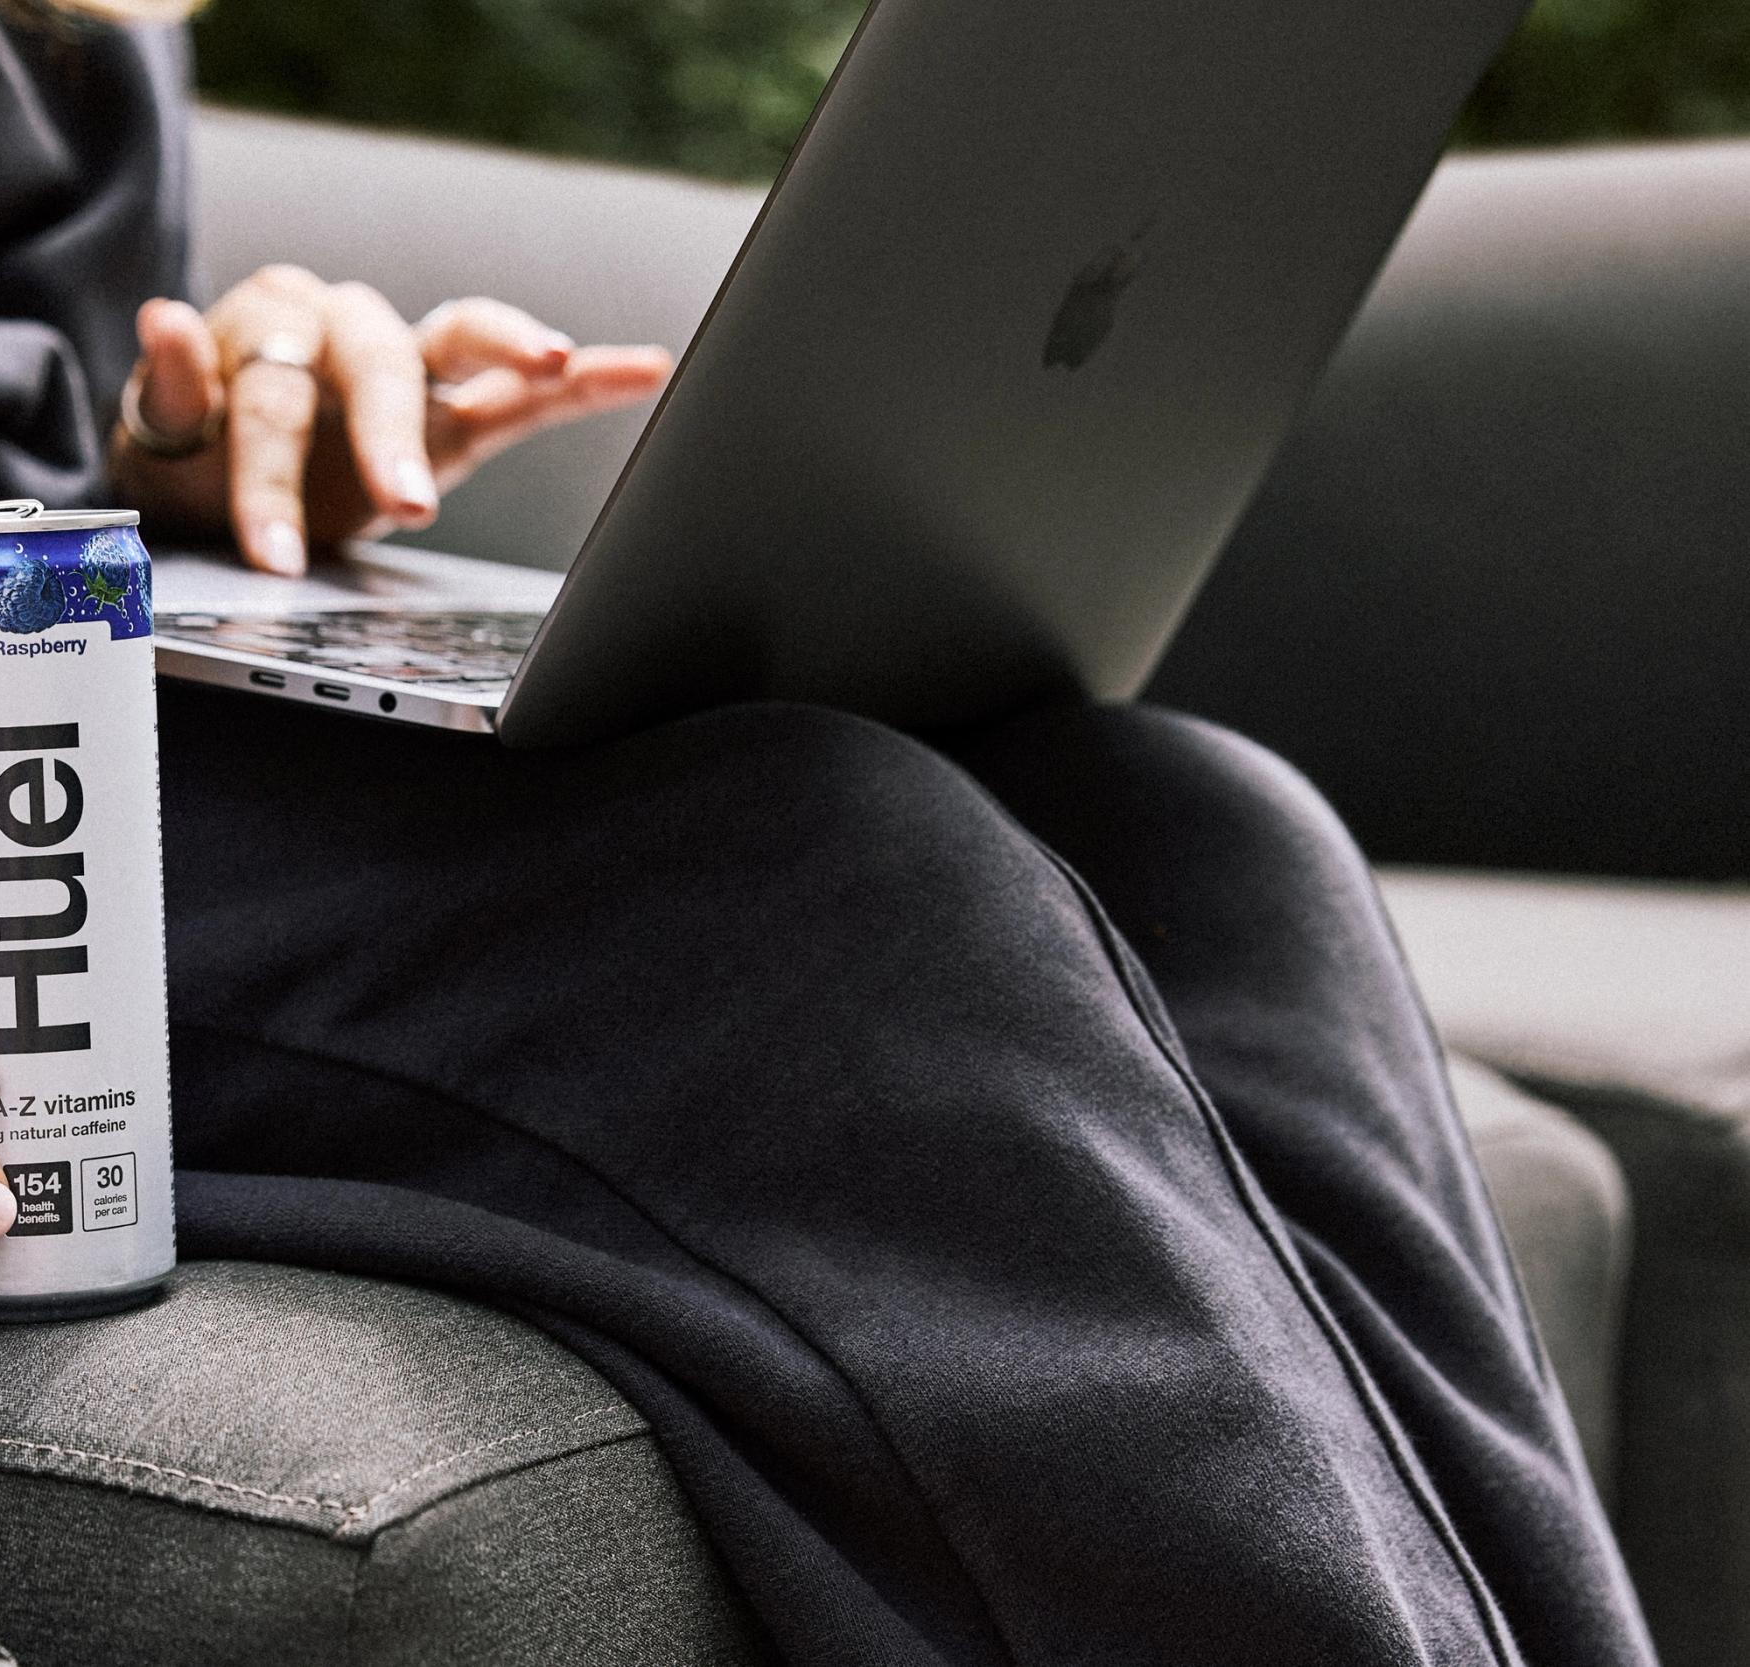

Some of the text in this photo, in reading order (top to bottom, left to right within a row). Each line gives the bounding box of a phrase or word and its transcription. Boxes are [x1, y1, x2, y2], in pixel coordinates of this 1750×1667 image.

[44, 1088, 136, 1115] vitamins
[10, 1124, 66, 1141] natural
[71, 1119, 126, 1137] caffeine
[13, 1171, 62, 1196] 154
[97, 1164, 124, 1189] 30
[22, 1201, 55, 1212] health
[94, 1193, 128, 1206] calories
[17, 1213, 60, 1225] benefits
[95, 1205, 127, 1219] per can
